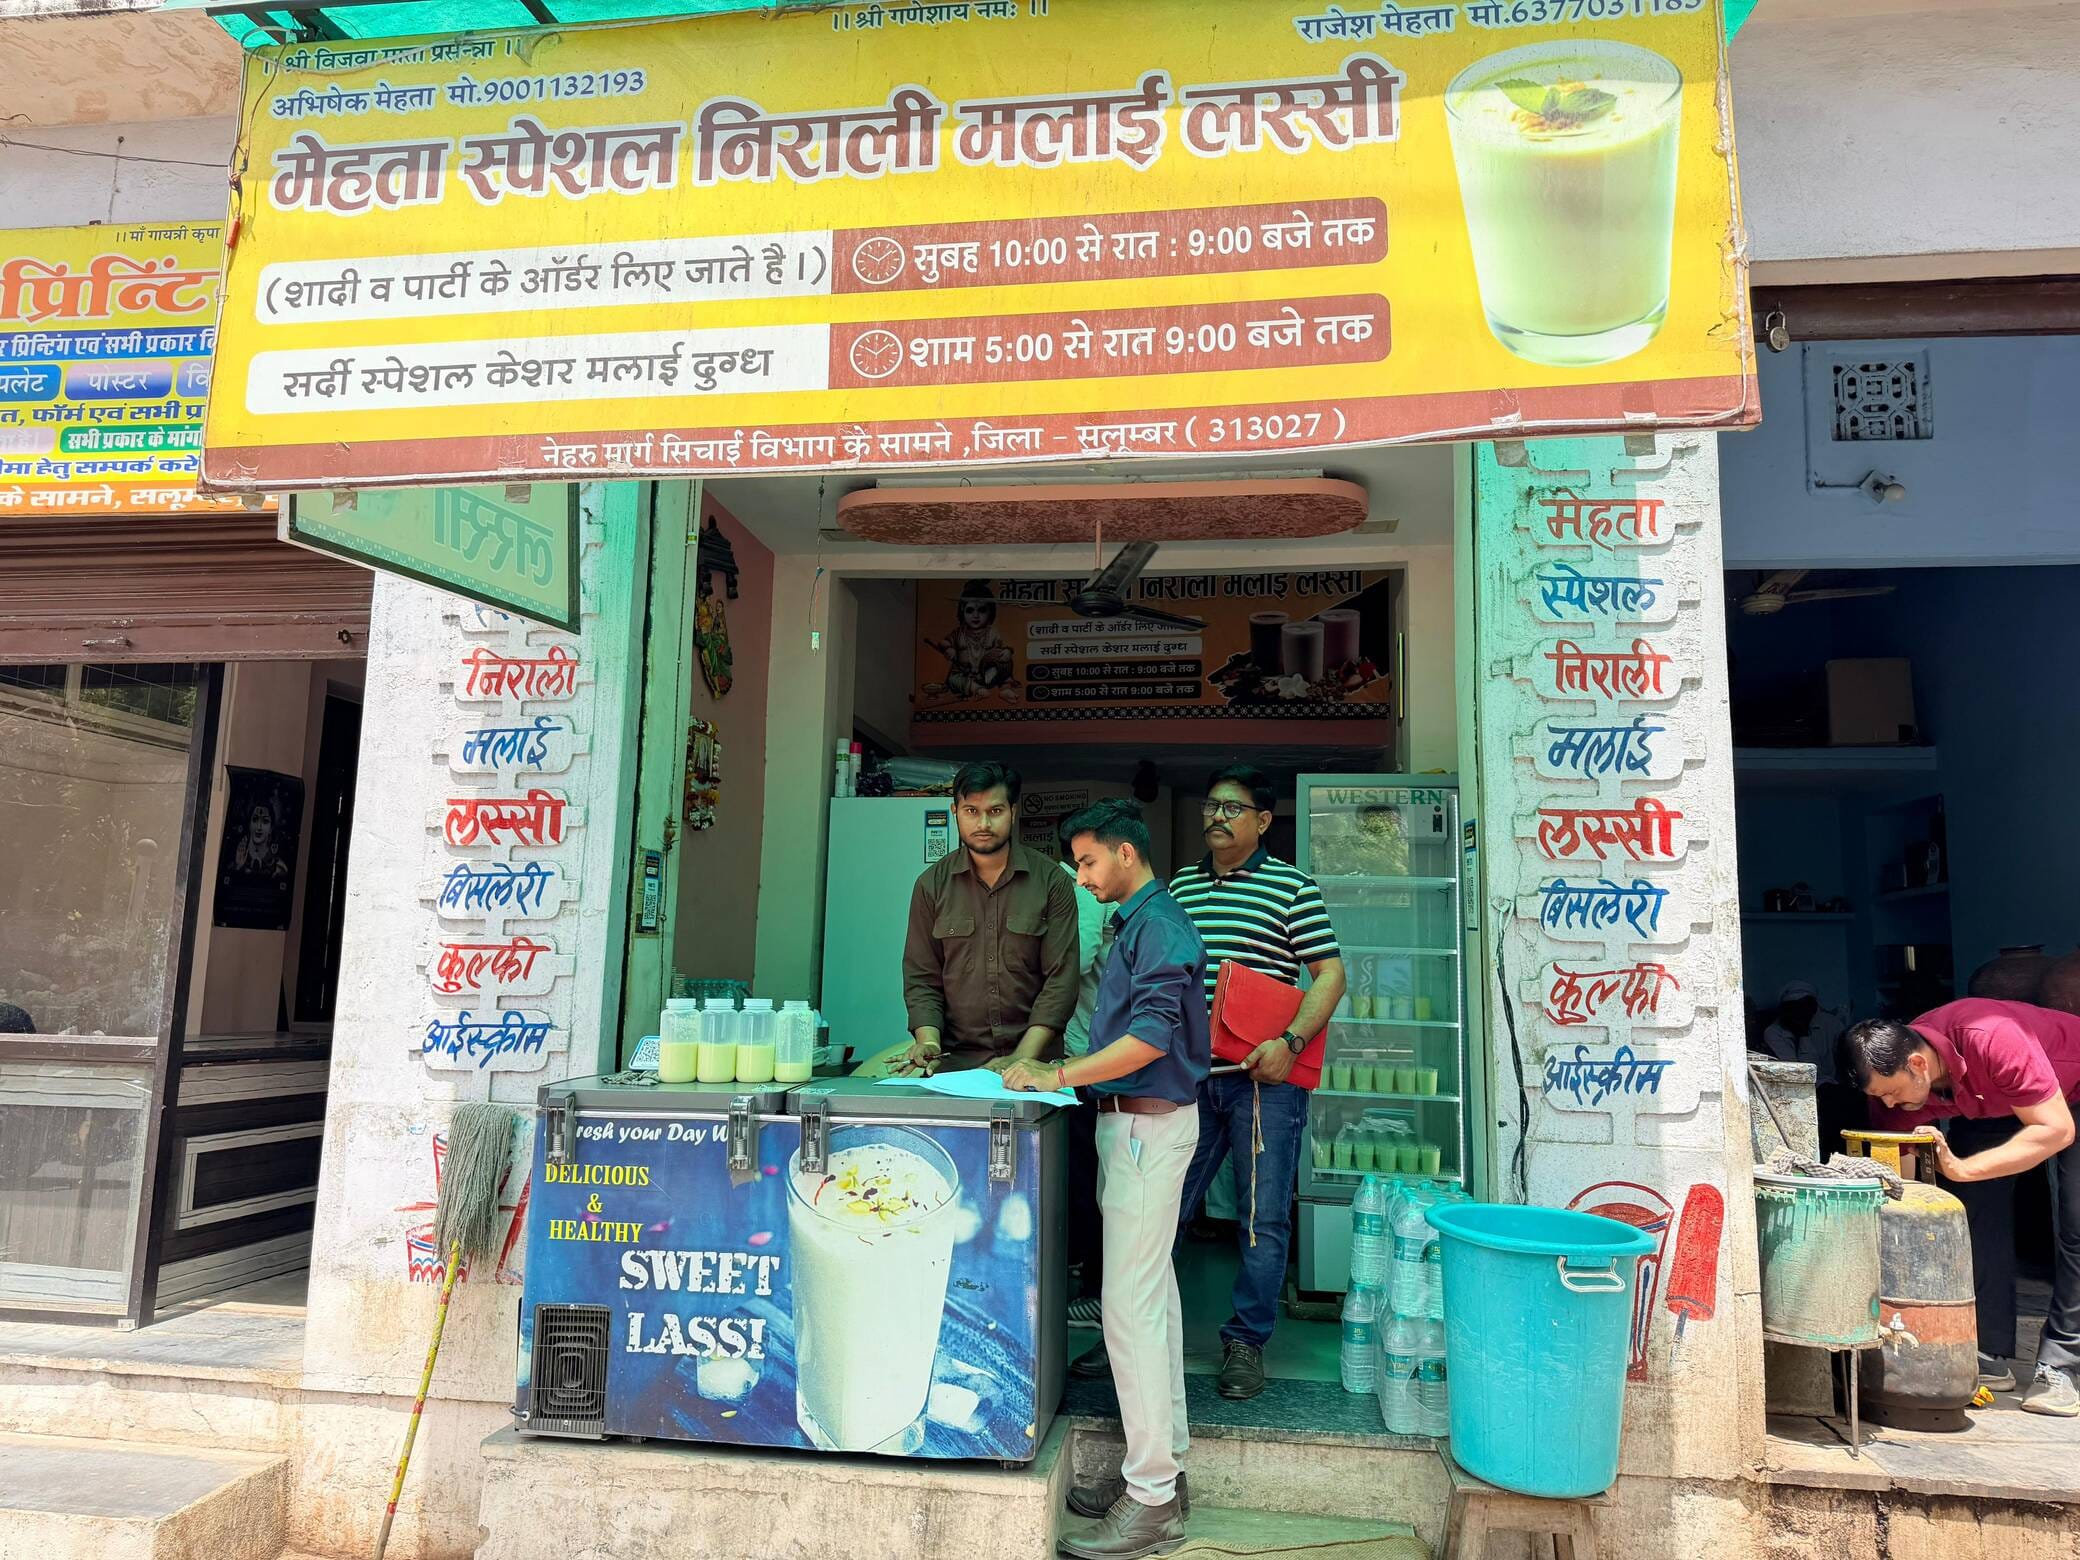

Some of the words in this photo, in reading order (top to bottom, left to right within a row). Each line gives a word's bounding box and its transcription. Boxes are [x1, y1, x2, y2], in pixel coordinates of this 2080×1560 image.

[855, 4, 885, 29] श्री
[889, 0, 969, 24] गणेशाय
[974, 1, 1017, 19] नमः
[1298, 11, 1374, 40] राजेश
[1382, 3, 1454, 36] मेहता
[285, 50, 309, 72] श्री
[272, 86, 368, 118] अभिषेक
[375, 79, 436, 109] मेहता
[448, 70, 645, 107] मो.9001132193
[274, 134, 448, 211] मेहता
[459, 120, 682, 204] स्पेशल
[698, 90, 941, 182] निराली
[959, 76, 1168, 165] मलाई
[1185, 57, 1399, 151] लस्सी
[129, 225, 146, 242] माँ
[148, 225, 189, 241] गायत्री
[192, 227, 222, 244] कृपा
[914, 239, 981, 284] सुबह
[990, 237, 1068, 267] 10:00
[1077, 225, 1104, 261] से
[1111, 228, 1159, 259] रात
[1188, 226, 1253, 257] 9:00
[1261, 210, 1312, 251] बजे
[1322, 215, 1376, 247] तक
[0, 255, 219, 324] प्रिन्टिं
[371, 282, 391, 303] व
[403, 264, 472, 302] पार्टी
[480, 259, 512, 297] के
[520, 255, 599, 294] ऑर्डर
[612, 253, 673, 291] लिए
[685, 246, 763, 285] जाते
[763, 243, 791, 285] है
[105, 331, 143, 355] सभी
[145, 333, 196, 354] प्रकार
[909, 337, 976, 368] शाम
[985, 331, 1053, 363] 5:00
[1063, 319, 1093, 359] से
[1102, 324, 1154, 357] रात
[1165, 322, 1237, 355] 9:00
[1247, 306, 1305, 349] बजे
[1315, 313, 1374, 345] तक
[88, 364, 153, 392] पोस्टर
[283, 361, 352, 398] सर्दी
[361, 356, 475, 394] स्पेशल
[486, 351, 574, 390] केशर
[586, 342, 683, 385] मलाई
[692, 346, 775, 391] दुग्ध
[32, 402, 86, 422] फॉर्म
[89, 402, 127, 423] एवं
[130, 400, 181, 421] सभी
[185, 404, 207, 421] प्र
[67, 426, 101, 450] सभी
[102, 429, 146, 450] प्रकार
[148, 426, 165, 449] के
[603, 432, 654, 466] मार्ग
[660, 429, 745, 467] सिचाई
[750, 427, 835, 460] विभाग
[842, 425, 872, 456] के
[878, 422, 953, 455] सामने
[1208, 412, 1323, 443] 313027
[36, 457, 72, 481] हेतु
[75, 455, 156, 474] सम्पर्क
[1538, 488, 1665, 552] मेहता
[1536, 563, 1664, 619] स्पेशल
[1040, 643, 1061, 656] सर्दी
[1064, 643, 1099, 655] स्पेशल
[1103, 641, 1129, 654] केशर
[1132, 640, 1161, 653] मलाई
[1072, 622, 1093, 634] पार्टी
[1095, 621, 1105, 633] के
[461, 645, 581, 700] निराली
[1051, 667, 1074, 681] सुबह
[1076, 666, 1101, 676] 10:00
[1103, 663, 1112, 676] से
[1114, 666, 1129, 676] रात
[1137, 665, 1158, 675] 9:00
[1159, 663, 1176, 675] बजे
[1178, 664, 1196, 673] तक
[1051, 686, 1072, 697] शाम
[1074, 686, 1097, 697] 5:00
[1098, 683, 1109, 697] से
[1111, 685, 1128, 696] रात
[1130, 685, 1153, 696] 9:00
[1155, 683, 1174, 695] बजे
[1176, 684, 1195, 694] तक
[462, 715, 563, 770] मलाई
[1547, 717, 1666, 777] मलाई
[445, 788, 566, 846] लस्सी
[1326, 789, 1443, 805] WESTERN
[1536, 797, 1684, 861] लस्सी
[439, 861, 555, 915] बिसलेरी
[1538, 878, 1670, 938] बिसलेरी
[573, 1121, 614, 1142] resh
[619, 1125, 662, 1144] your
[667, 1122, 707, 1146] Day
[544, 1162, 650, 1187] DELICIOUS
[586, 1192, 604, 1214] &
[549, 1220, 643, 1244] HEALTHY
[618, 1249, 781, 1297] SWEET
